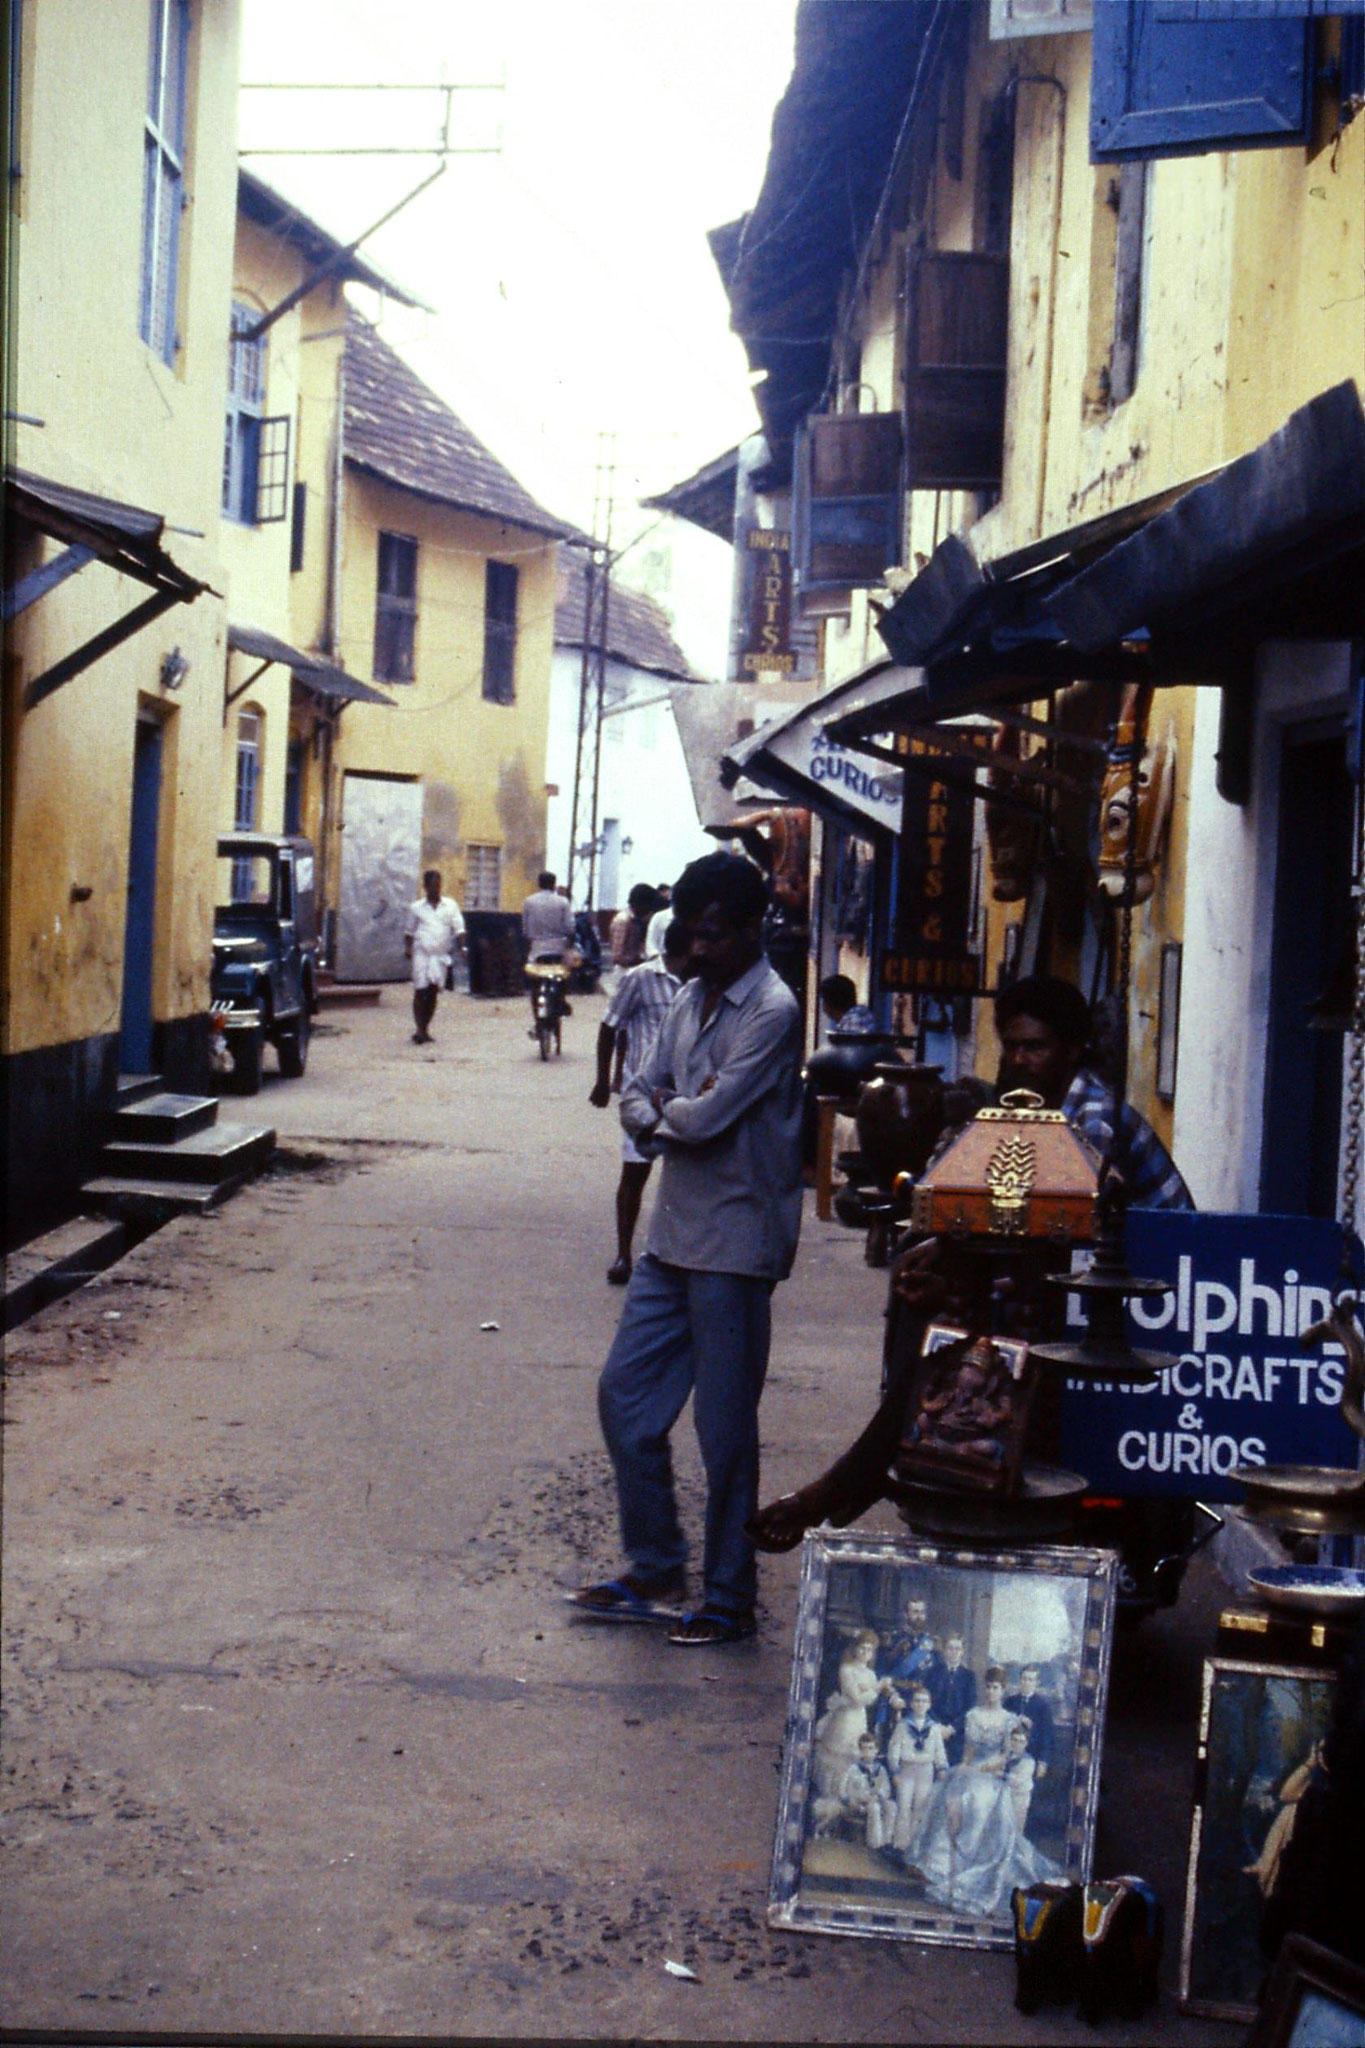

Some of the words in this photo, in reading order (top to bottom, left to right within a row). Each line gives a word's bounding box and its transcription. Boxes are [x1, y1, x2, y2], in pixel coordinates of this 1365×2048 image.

[761, 553, 782, 648] ARTS
[1066, 1353, 1345, 1405] ICRAFTS
[1178, 1403, 1203, 1430] &
[1118, 1430, 1266, 1475] CURIOS
